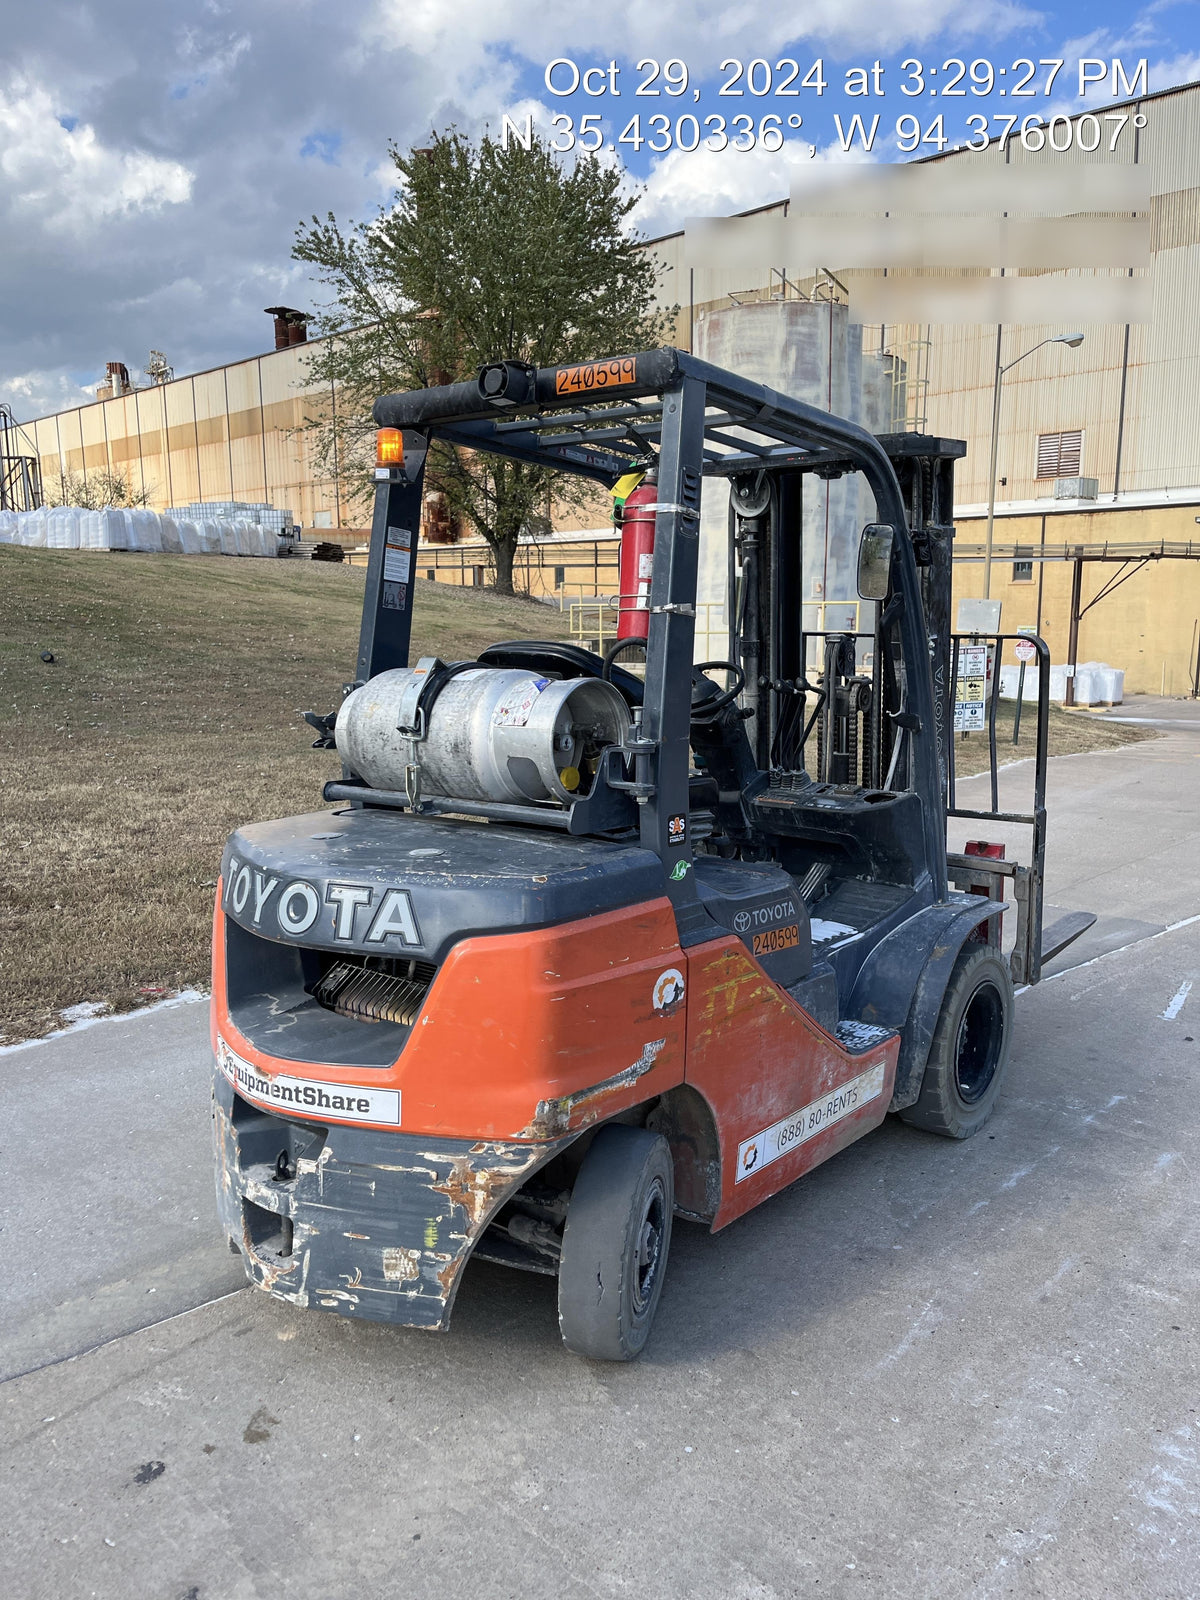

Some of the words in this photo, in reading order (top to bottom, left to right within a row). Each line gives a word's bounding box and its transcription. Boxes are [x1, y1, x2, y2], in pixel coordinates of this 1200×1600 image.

[558, 359, 635, 393] 240599
[668, 816, 686, 835] SAS
[225, 858, 422, 946] TOYOTA
[752, 901, 796, 925] TOYOTA
[753, 925, 799, 956] 240599
[777, 1118, 805, 1150] (888)
[808, 1086, 859, 1129] 80-RENTS
